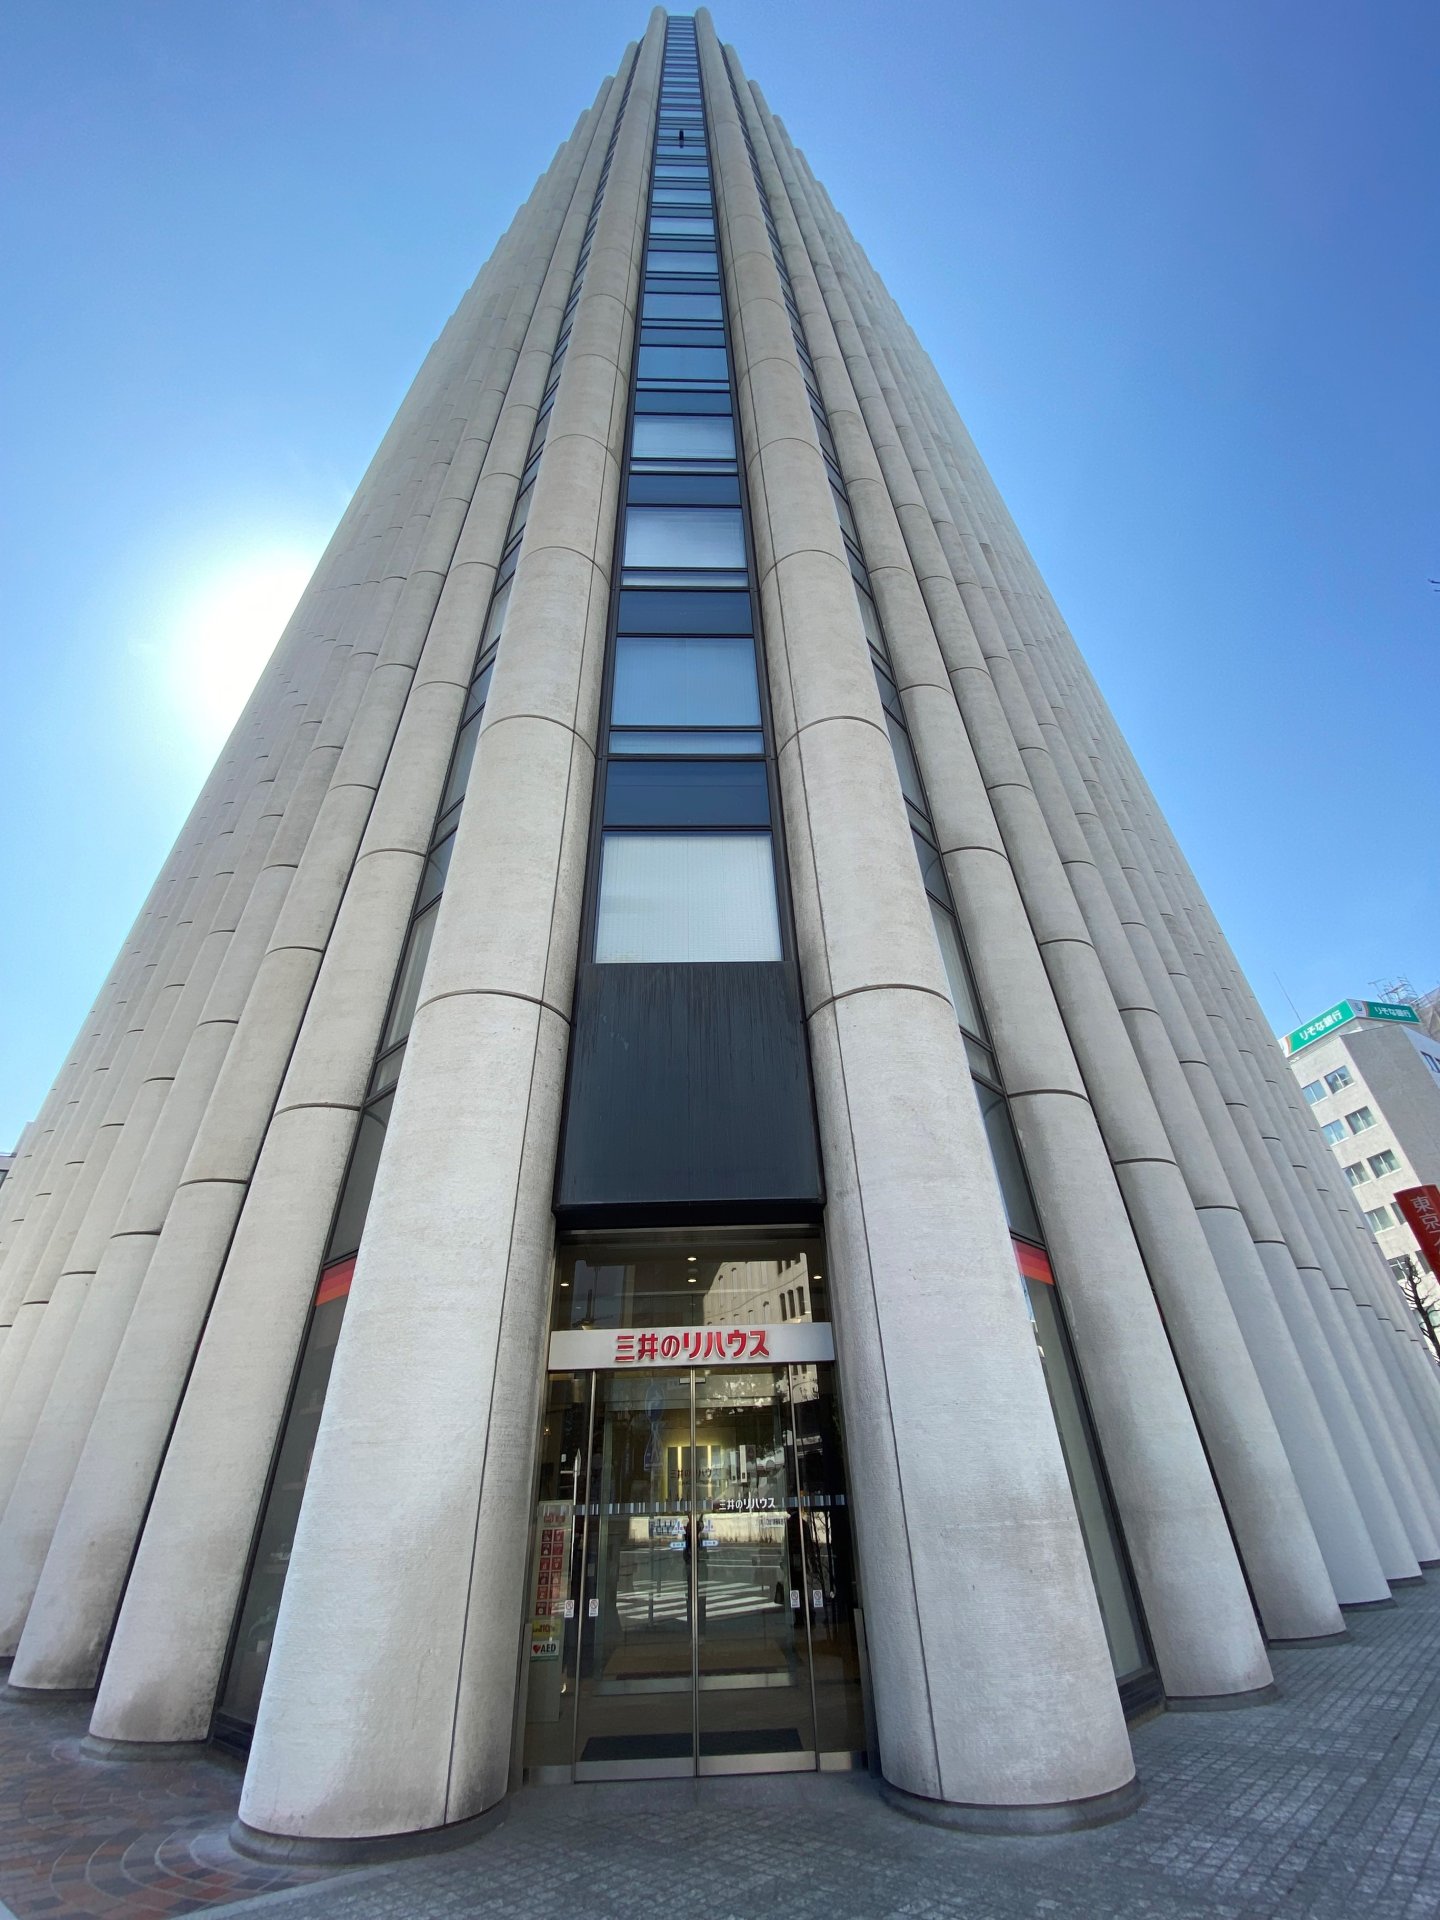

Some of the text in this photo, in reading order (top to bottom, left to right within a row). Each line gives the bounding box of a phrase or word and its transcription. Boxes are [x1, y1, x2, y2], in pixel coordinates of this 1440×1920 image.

[1374, 1006, 1412, 1018] りそな銀行
[1299, 1009, 1343, 1041] りそな銀行
[615, 1329, 770, 1362] 三井のリハウス
[719, 1497, 776, 1511] 三井のリハウス
[540, 1643, 557, 1653] AED
